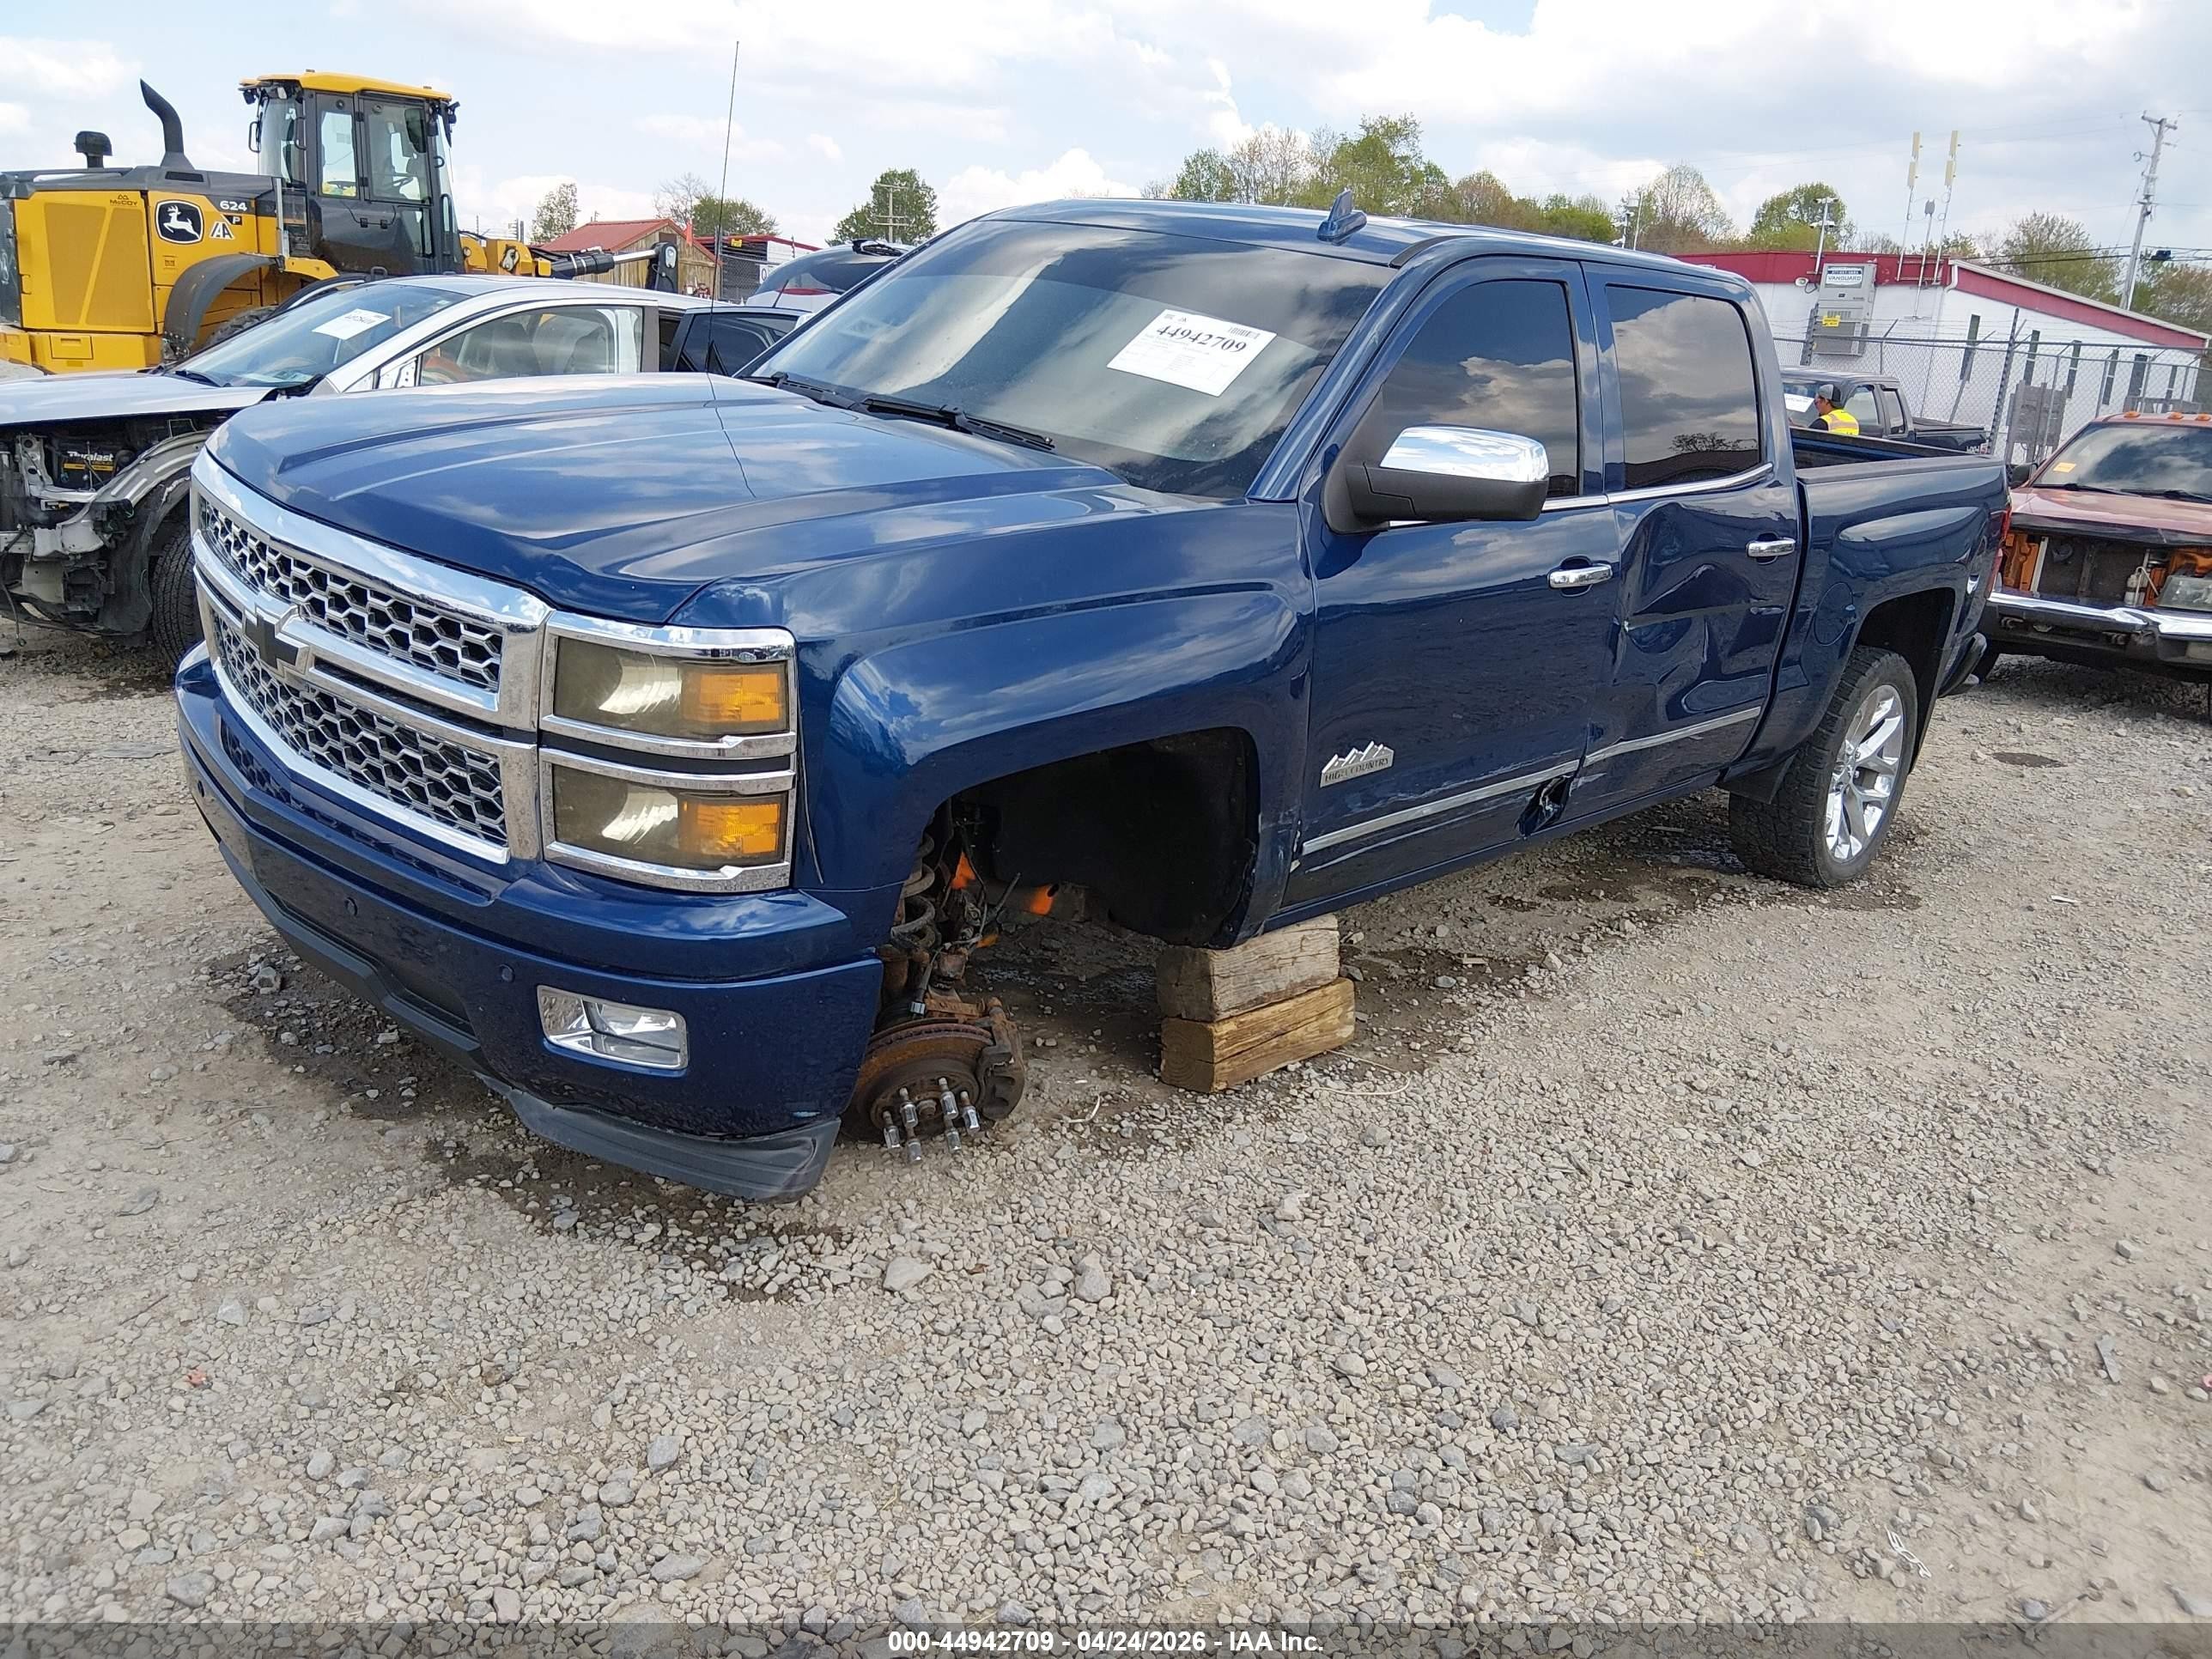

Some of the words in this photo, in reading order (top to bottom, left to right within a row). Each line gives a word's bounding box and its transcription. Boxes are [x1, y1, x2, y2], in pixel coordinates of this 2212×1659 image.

[219, 200, 248, 211] 624
[232, 216, 241, 225] P
[1156, 325, 1248, 353] 44942709
[1351, 757, 1389, 775] COUNTRY
